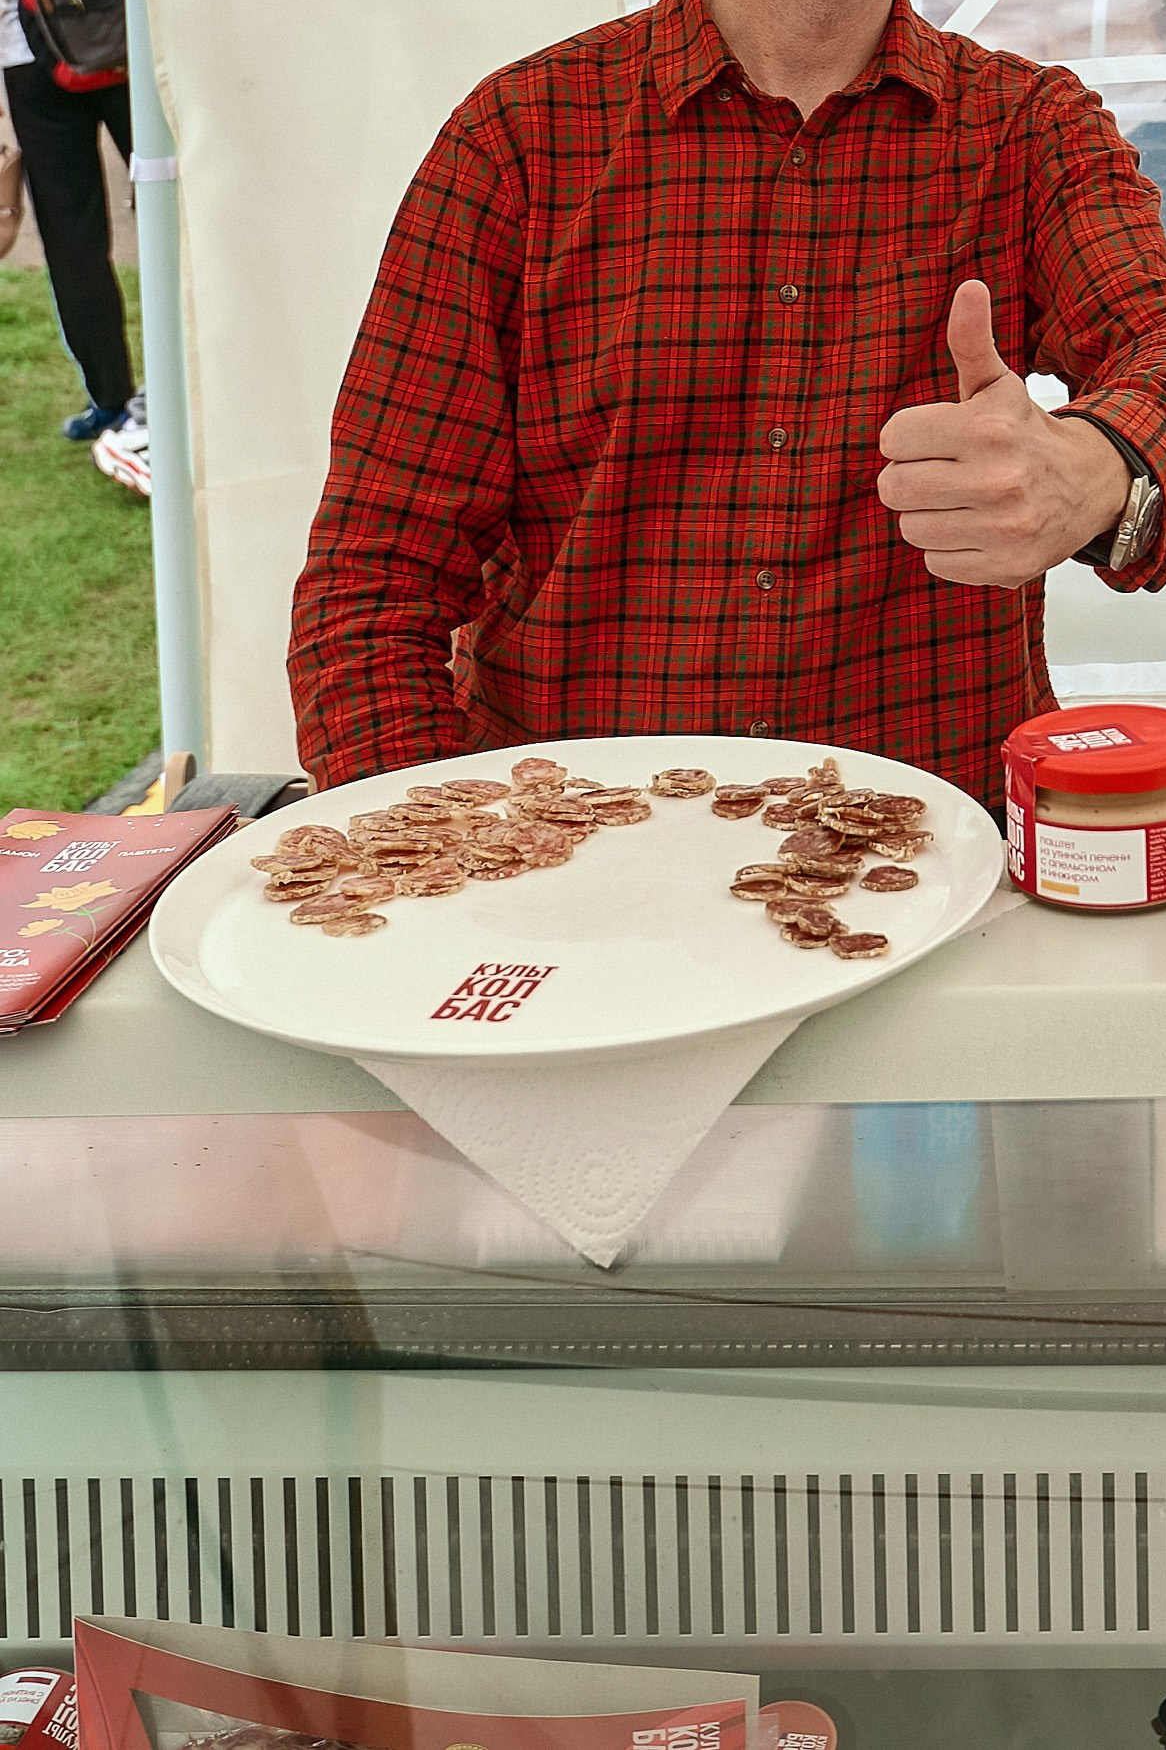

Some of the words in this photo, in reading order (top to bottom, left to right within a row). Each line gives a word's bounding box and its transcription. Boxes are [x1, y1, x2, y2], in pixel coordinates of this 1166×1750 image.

[66, 840, 122, 850] КУЛЬТ
[1039, 836, 1075, 849] паштет
[53, 849, 109, 860] КОЛ
[117, 847, 177, 857] ПАШТЕТЫ
[1052, 849, 1087, 861] утиной
[1089, 854, 1131, 862] печени
[40, 859, 98, 873] БАС
[1048, 859, 1117, 872] апельсином
[472, 963, 560, 978] КУЛЬТ
[453, 977, 542, 999] КОЛ
[430, 998, 521, 1022] БАС
